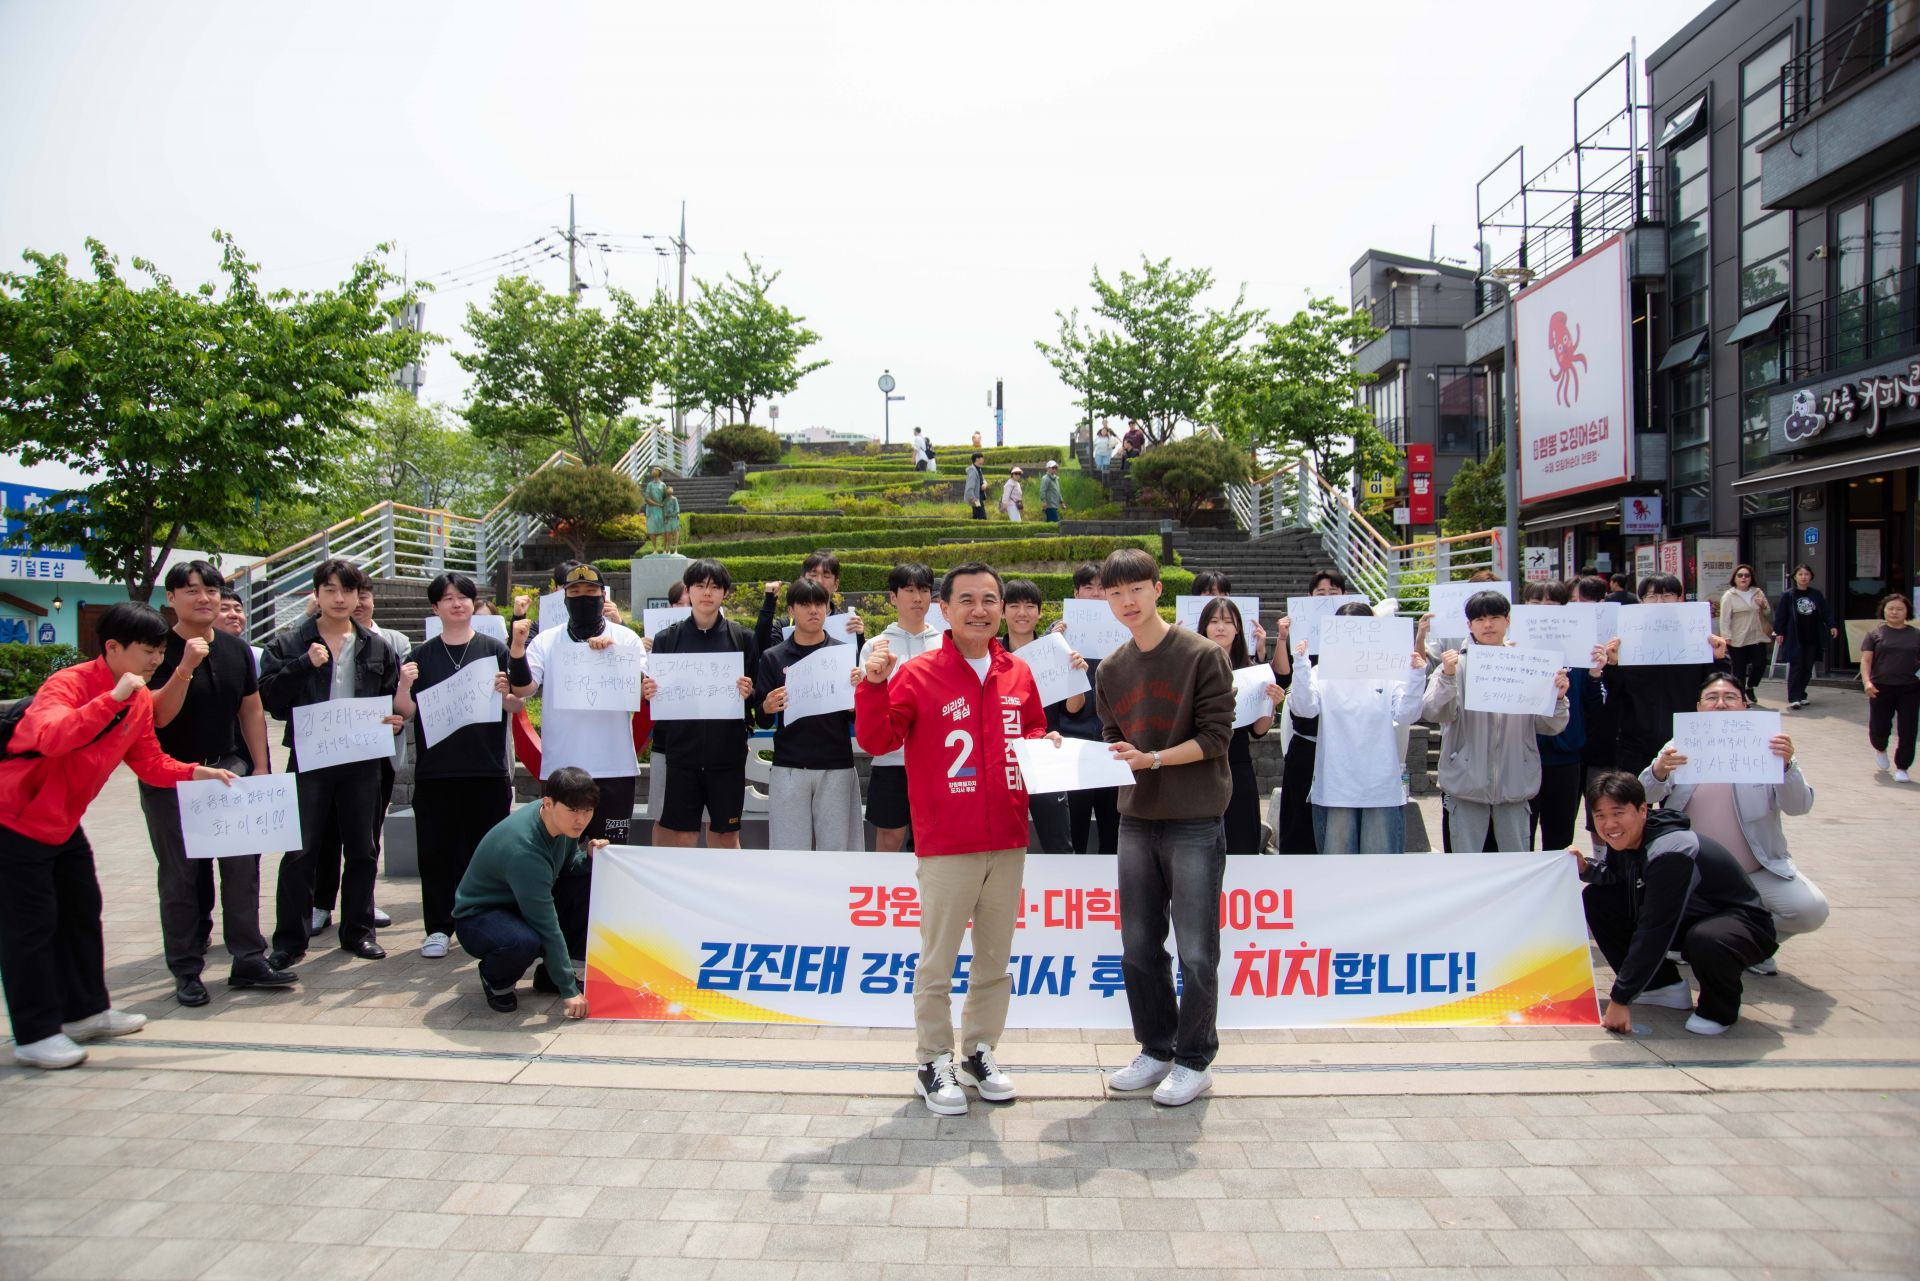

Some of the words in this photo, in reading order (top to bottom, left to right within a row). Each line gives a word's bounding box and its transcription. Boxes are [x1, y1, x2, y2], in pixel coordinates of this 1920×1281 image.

[1823, 385, 1855, 422] 강릉
[1560, 416, 1609, 453] 오징어순대
[1414, 479, 1430, 495] 빵
[11, 559, 65, 579] 키덜트샵
[41, 631, 54, 641] ADT
[1324, 619, 1383, 645] 강원은
[655, 661, 705, 678] 도지사님
[710, 661, 734, 679] 항상
[1353, 649, 1409, 673] 김진태
[941, 696, 966, 717] 의리와
[1001, 696, 1022, 706] 그래도
[302, 707, 352, 737] 김진태
[953, 705, 971, 722] 뚝심
[1688, 719, 1711, 735] 항상
[945, 729, 976, 778] 2
[1692, 753, 1769, 777] 감사합니다
[191, 798, 203, 816] 늘
[697, 942, 850, 995] 김진태
